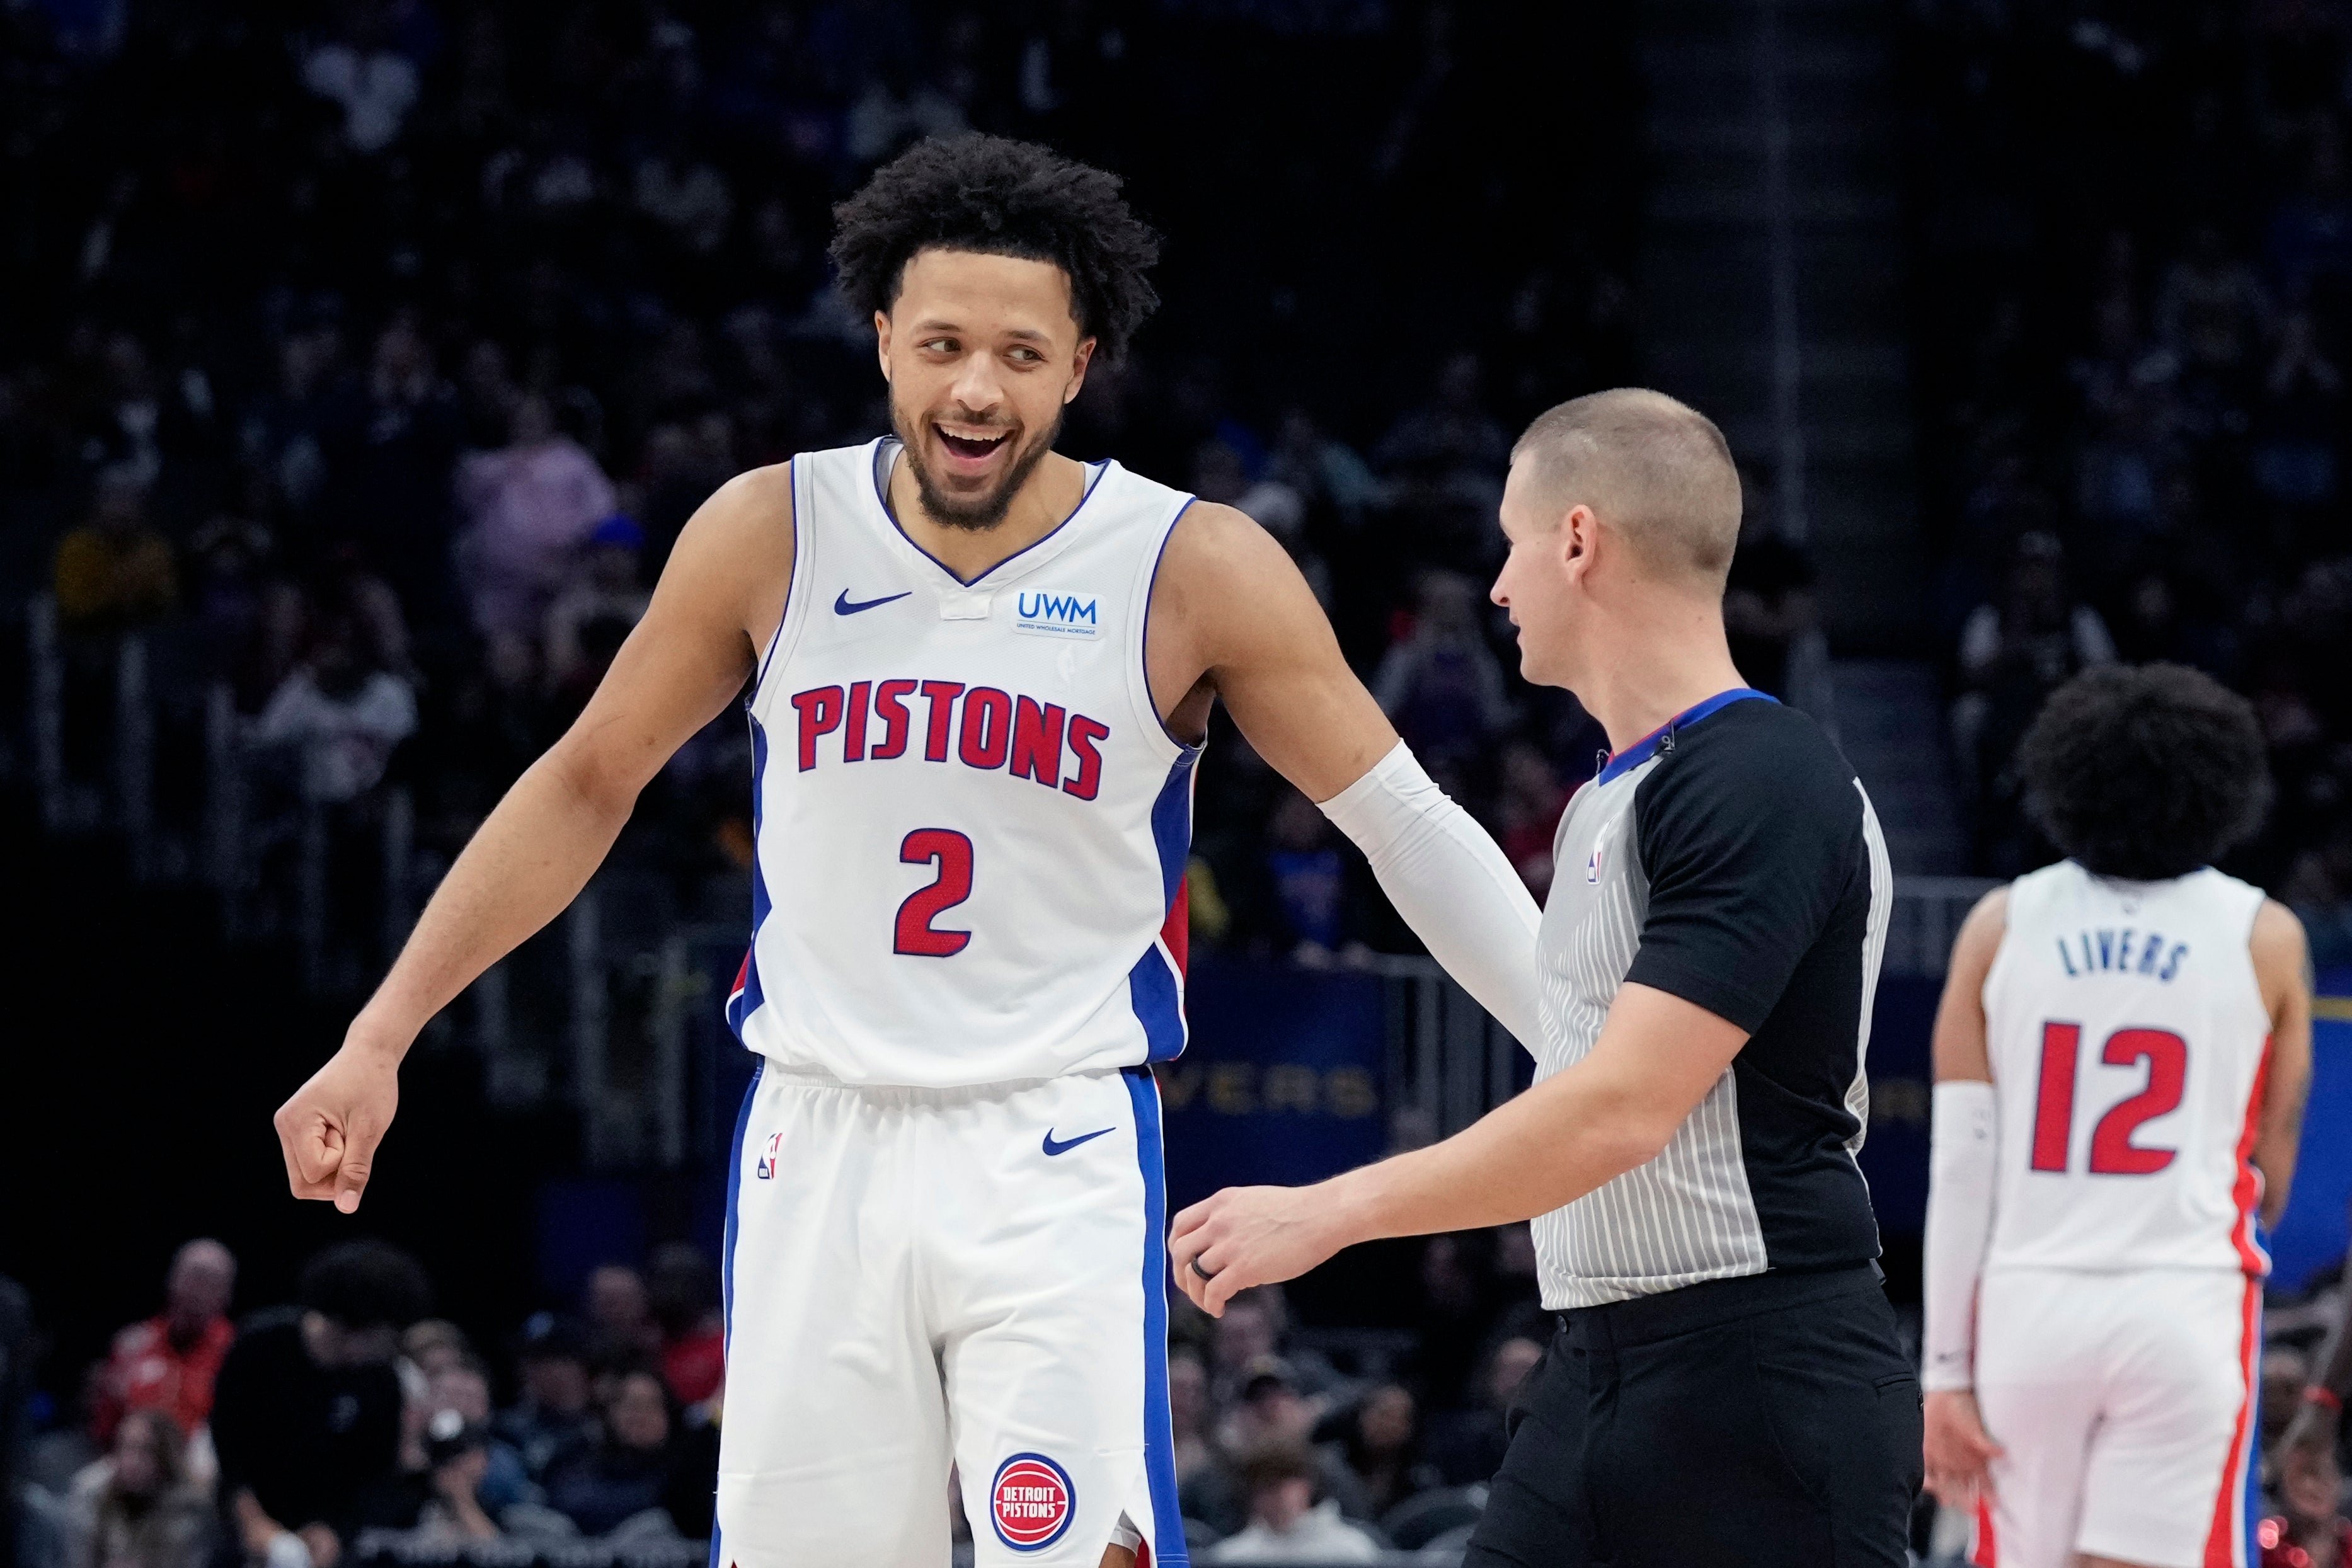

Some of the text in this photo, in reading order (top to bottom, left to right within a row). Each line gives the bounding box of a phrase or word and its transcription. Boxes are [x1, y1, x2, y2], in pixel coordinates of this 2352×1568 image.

[1018, 592, 1096, 624] UWM
[1036, 625, 1065, 633] WHOLESALE
[791, 678, 1110, 801] PISTONS
[893, 827, 974, 958] 2
[2057, 929, 2190, 982] LIVERS
[2031, 1021, 2188, 1176] 12
[1001, 1502, 1056, 1518] PISTONS
[1002, 1486, 1056, 1502] DETROIT
